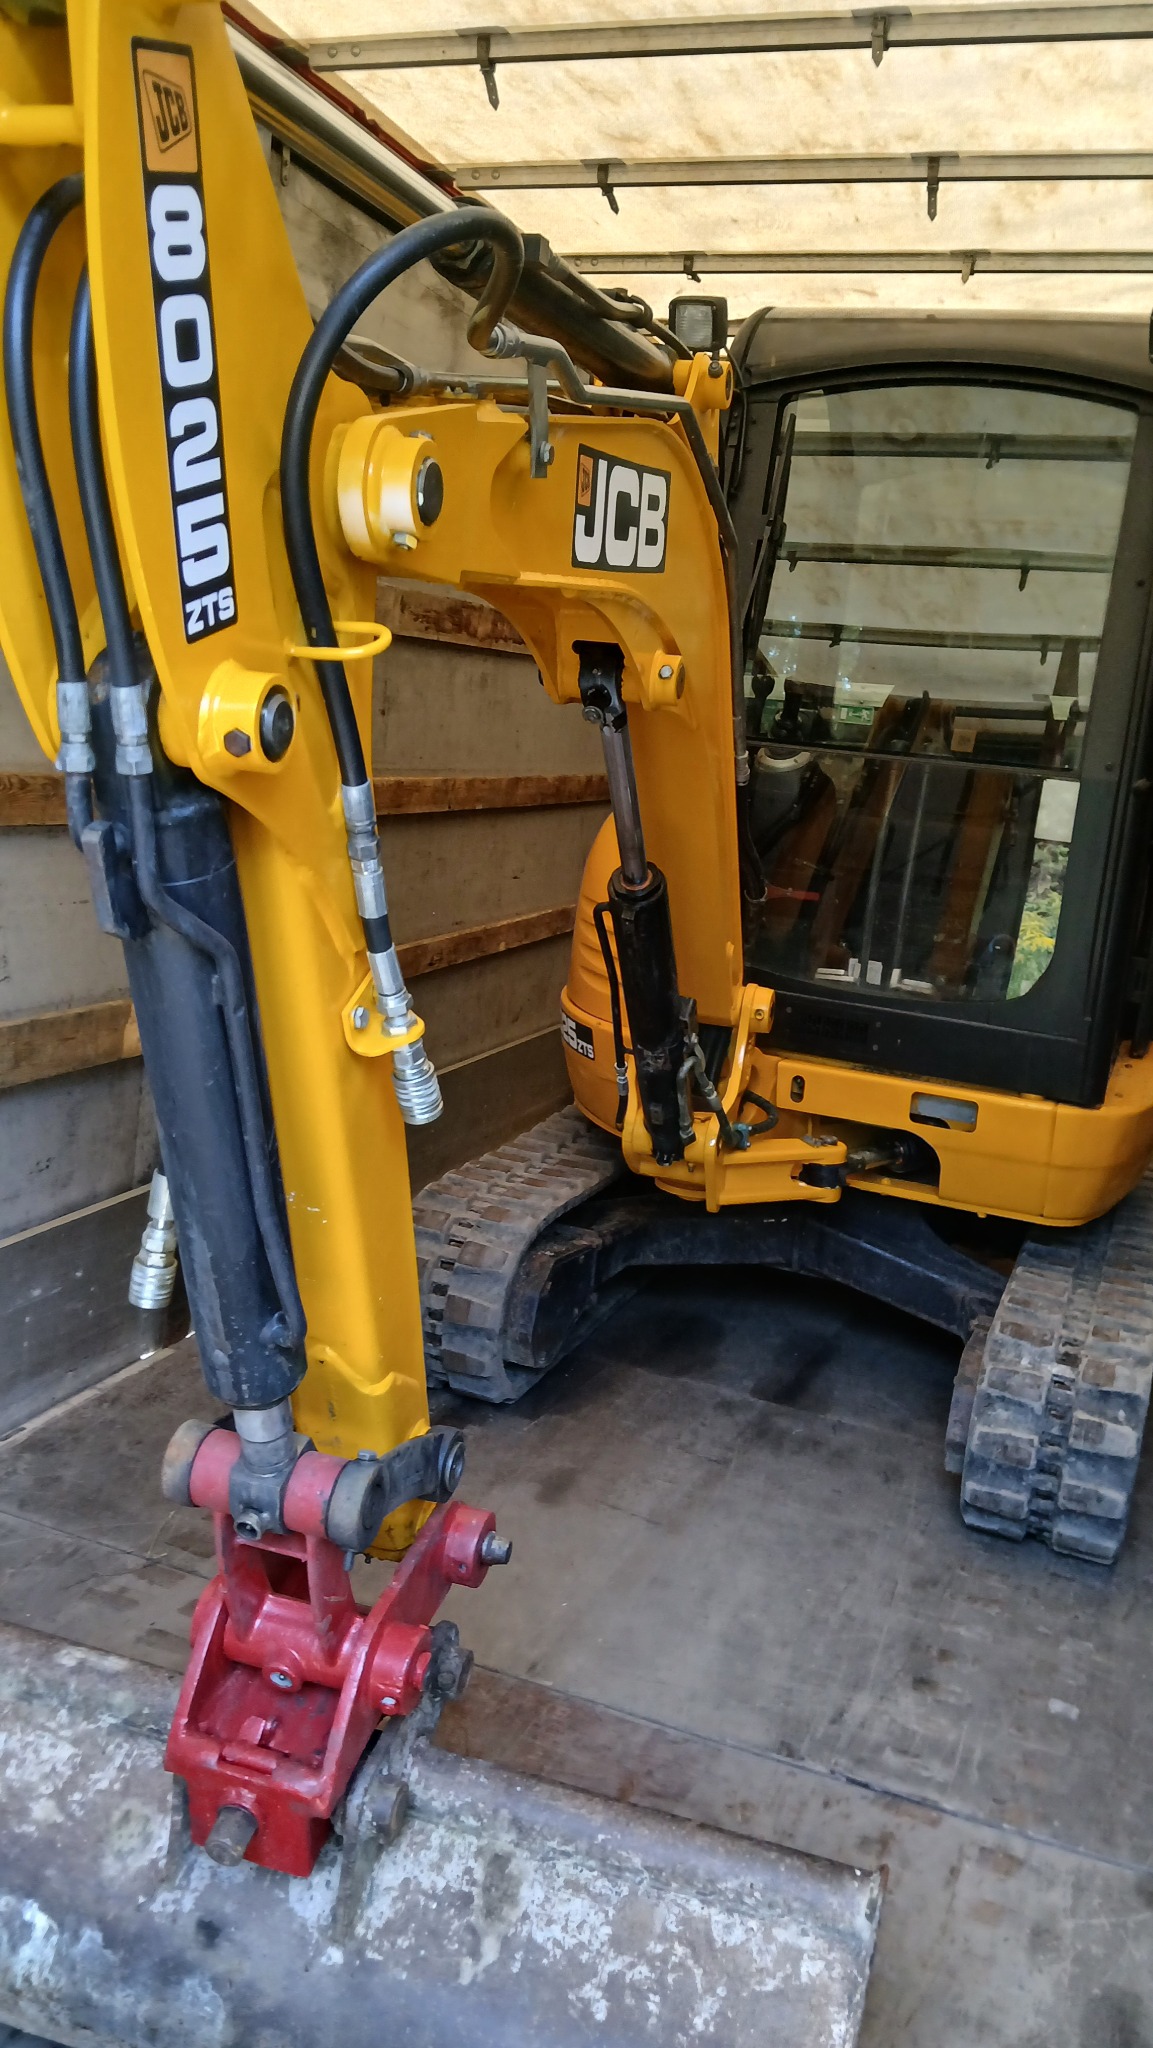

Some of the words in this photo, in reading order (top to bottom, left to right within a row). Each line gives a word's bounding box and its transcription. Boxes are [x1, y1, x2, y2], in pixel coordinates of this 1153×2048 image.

[151, 80, 189, 143] JCB
[150, 184, 230, 587] 8025
[574, 458, 667, 568] JCB
[184, 586, 235, 636] ZTS
[577, 1039, 595, 1059] ZTS
